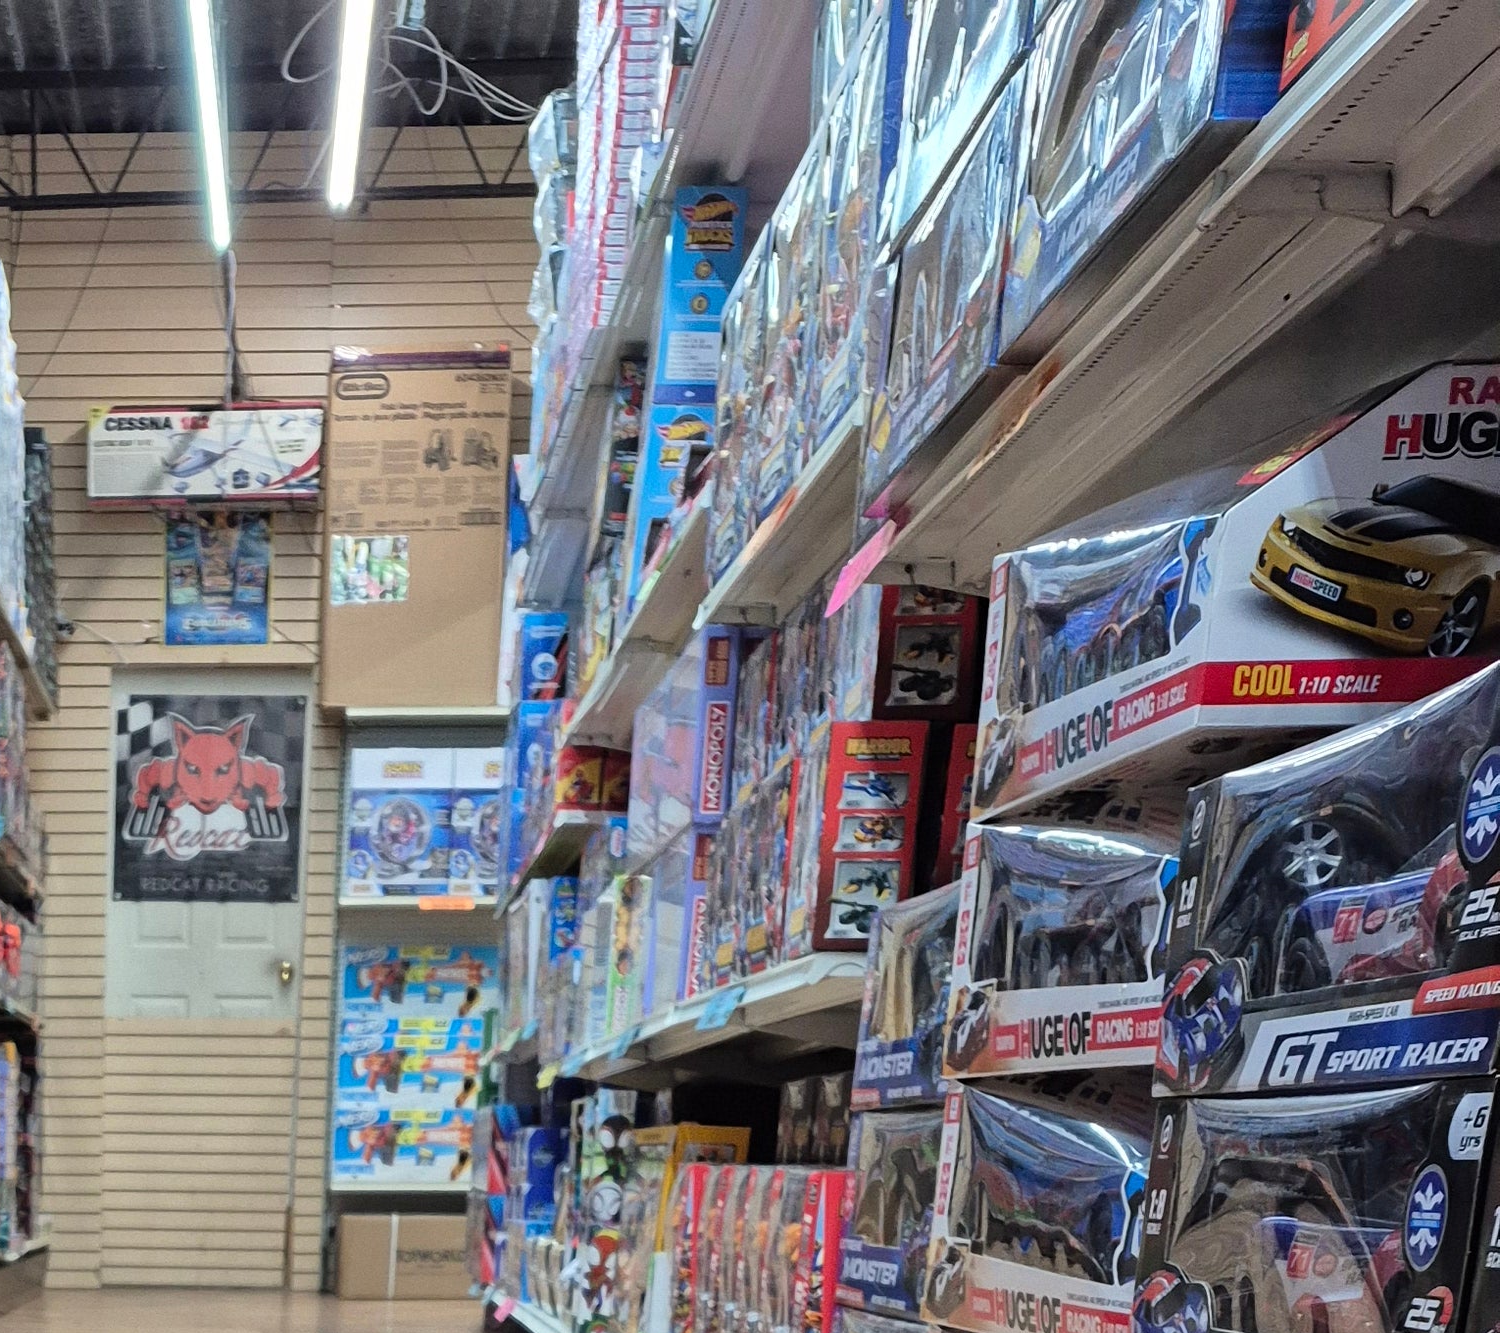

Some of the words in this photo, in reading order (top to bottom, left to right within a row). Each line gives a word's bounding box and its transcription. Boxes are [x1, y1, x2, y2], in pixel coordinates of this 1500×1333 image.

[105, 416, 173, 432] CESSNA
[1382, 410, 1500, 458] HUG
[1233, 664, 1296, 697] COOL
[1299, 676, 1332, 695] 1:10
[1331, 674, 1382, 695] SCALE
[1118, 692, 1156, 731] RACING
[706, 705, 728, 812] MONOPOLY
[140, 877, 200, 893] REDCAT
[205, 877, 270, 893] RACING
[1179, 875, 1199, 913] 1:8
[1459, 885, 1500, 926] 25
[1424, 986, 1457, 1004] SPEED
[1096, 1017, 1134, 1044] RACING
[860, 1051, 914, 1082] MONSTER
[1268, 1030, 1340, 1086] GT
[1323, 1049, 1402, 1076] SPORT
[1399, 1036, 1490, 1066] RACER
[1463, 1105, 1489, 1129] +6
[1459, 1135, 1482, 1152] yrs
[1150, 1189, 1167, 1221] 1:8
[843, 1256, 900, 1288] MONSTER
[1404, 1297, 1442, 1333] 25
